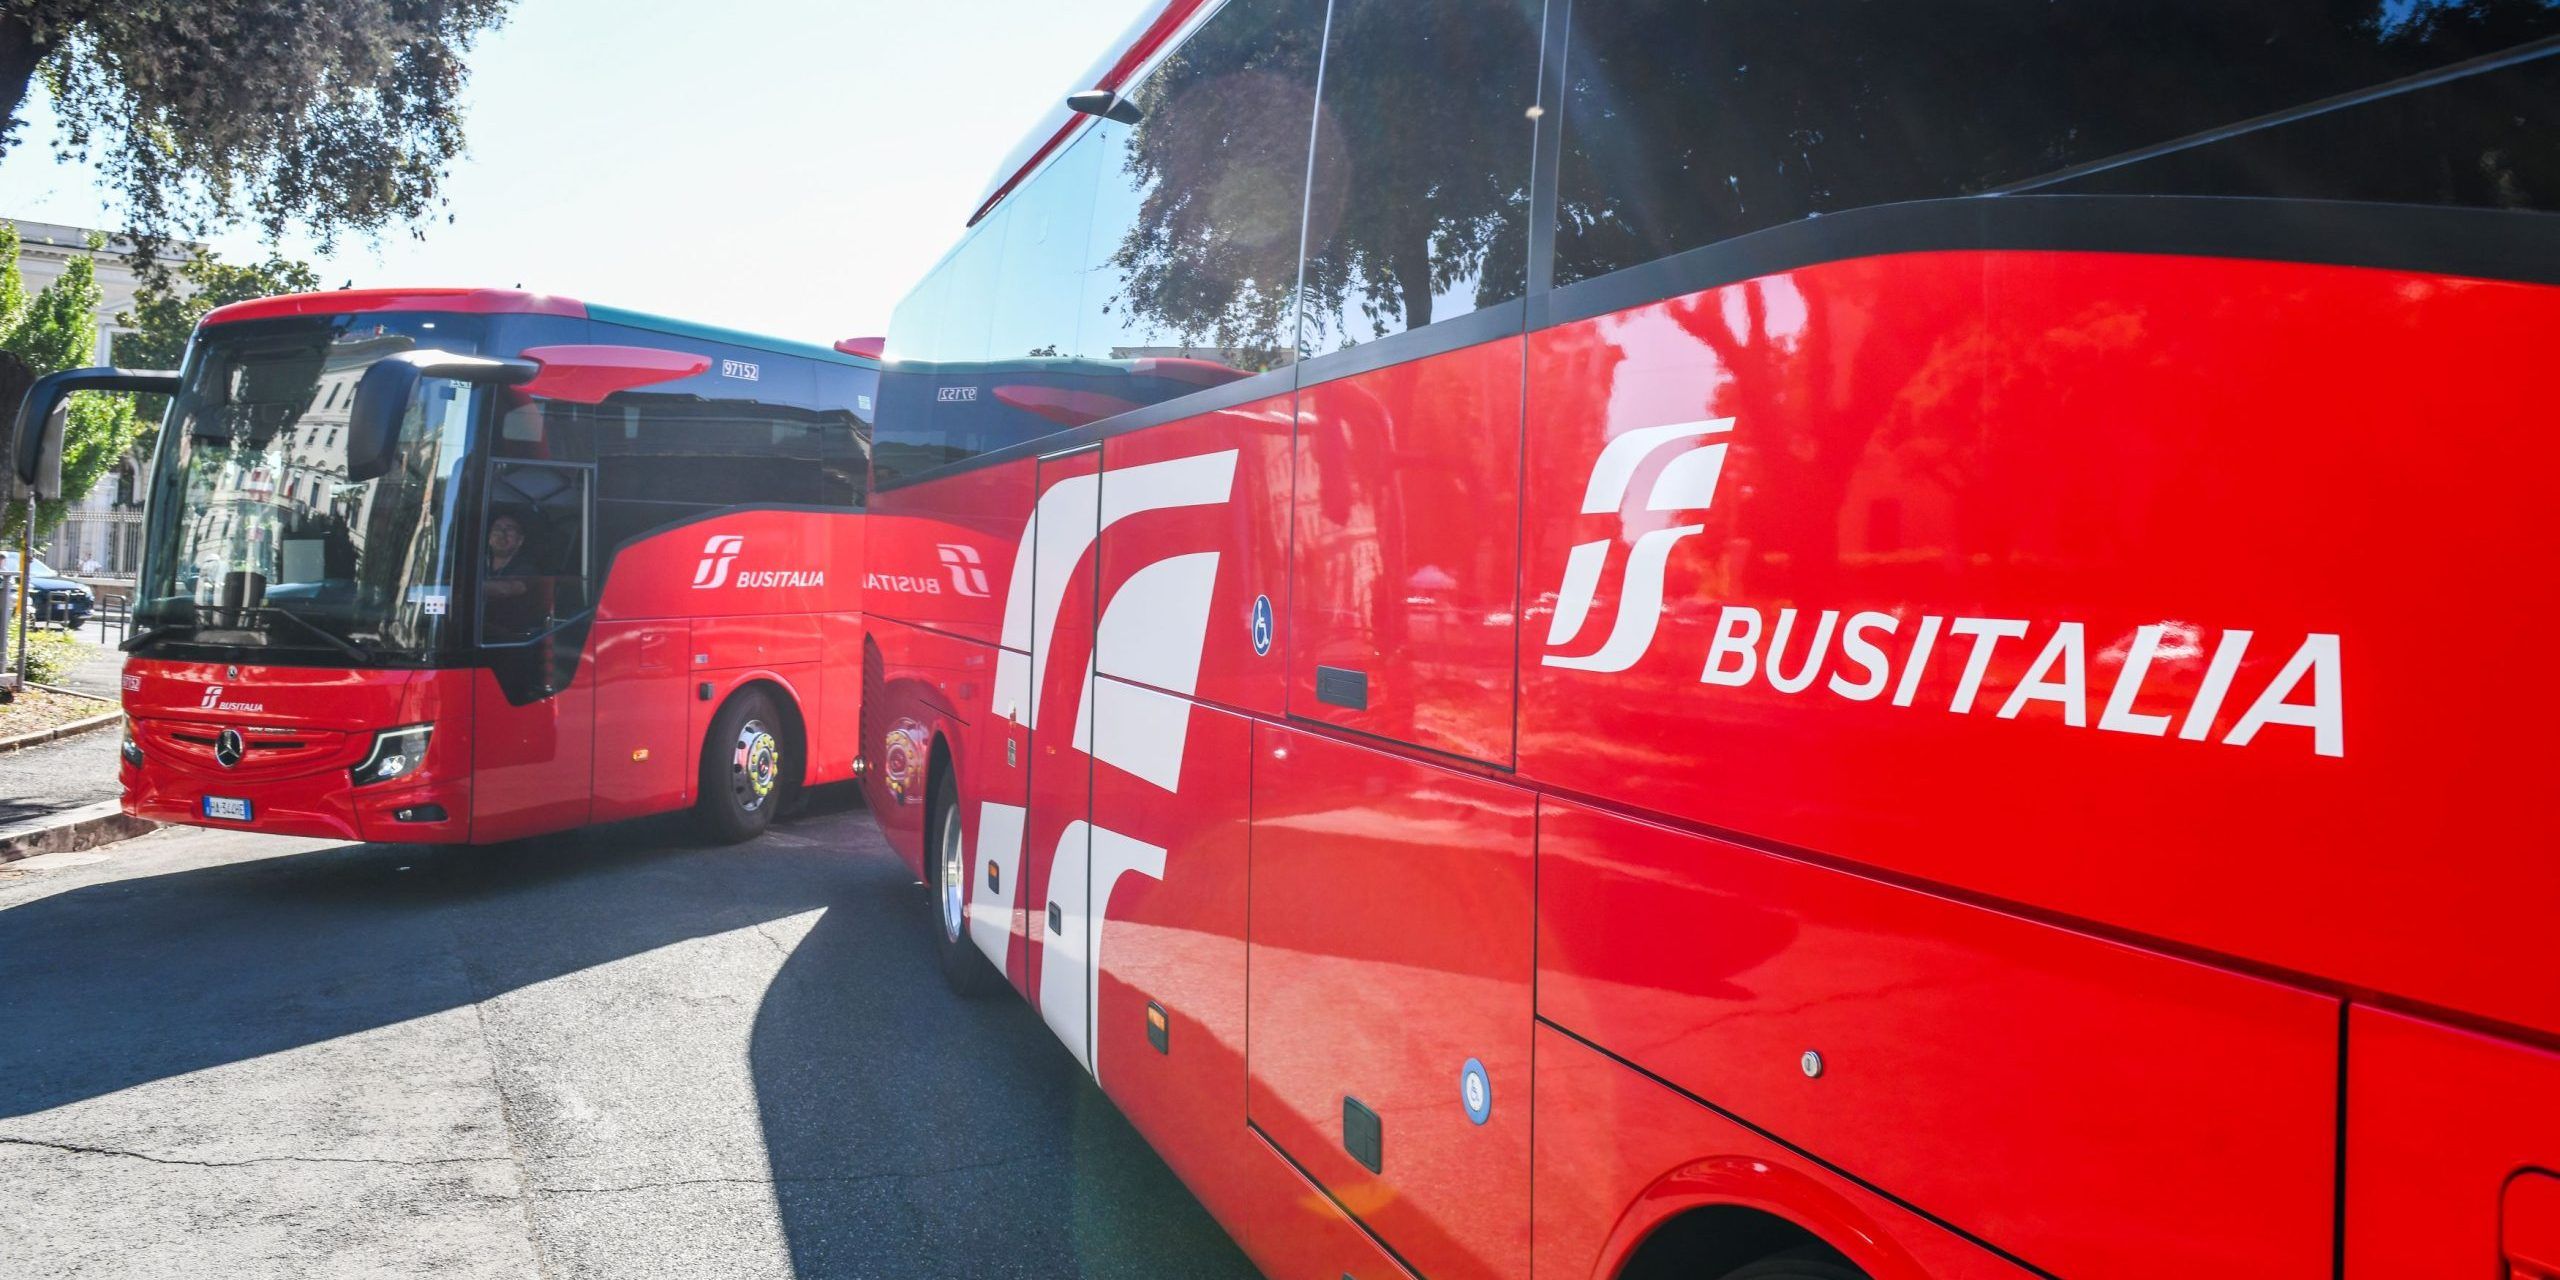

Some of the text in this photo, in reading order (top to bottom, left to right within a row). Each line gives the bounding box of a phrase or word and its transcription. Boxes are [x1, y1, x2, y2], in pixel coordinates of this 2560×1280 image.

[725, 362, 756, 379] 97152
[736, 571, 824, 588] BUSITALIA
[1700, 606, 2344, 758] BUSITALIA
[219, 701, 263, 712] BUSITALIA
